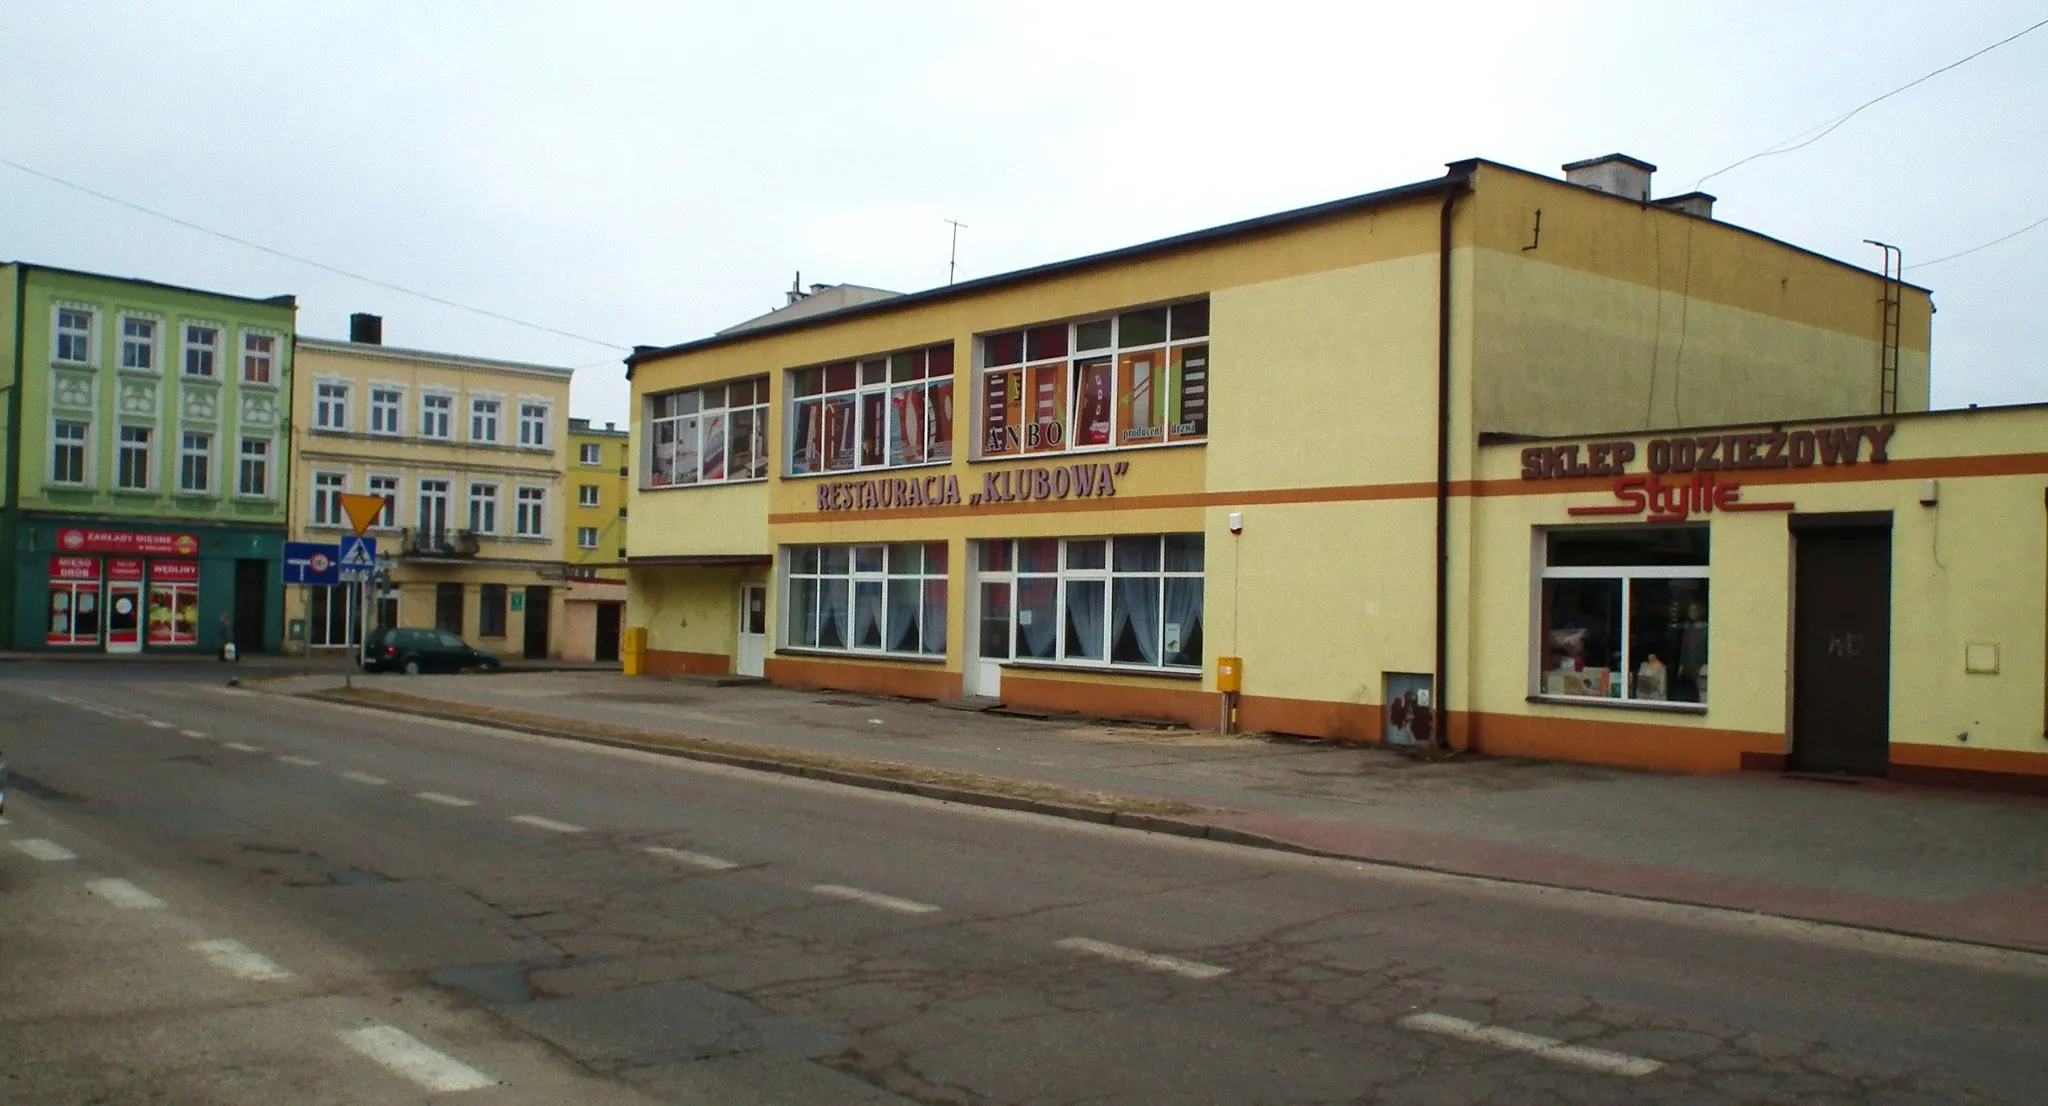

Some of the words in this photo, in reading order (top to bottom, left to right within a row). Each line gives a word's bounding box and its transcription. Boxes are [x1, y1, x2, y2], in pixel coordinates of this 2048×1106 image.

[986, 421, 1063, 451] ANBO
[1123, 425, 1164, 440] producent
[1170, 420, 1196, 435] drzwi
[1521, 441, 1635, 480] SKLEP
[1647, 423, 1895, 475] ODZIEŻOWY
[816, 475, 961, 511] RESTAURACJA
